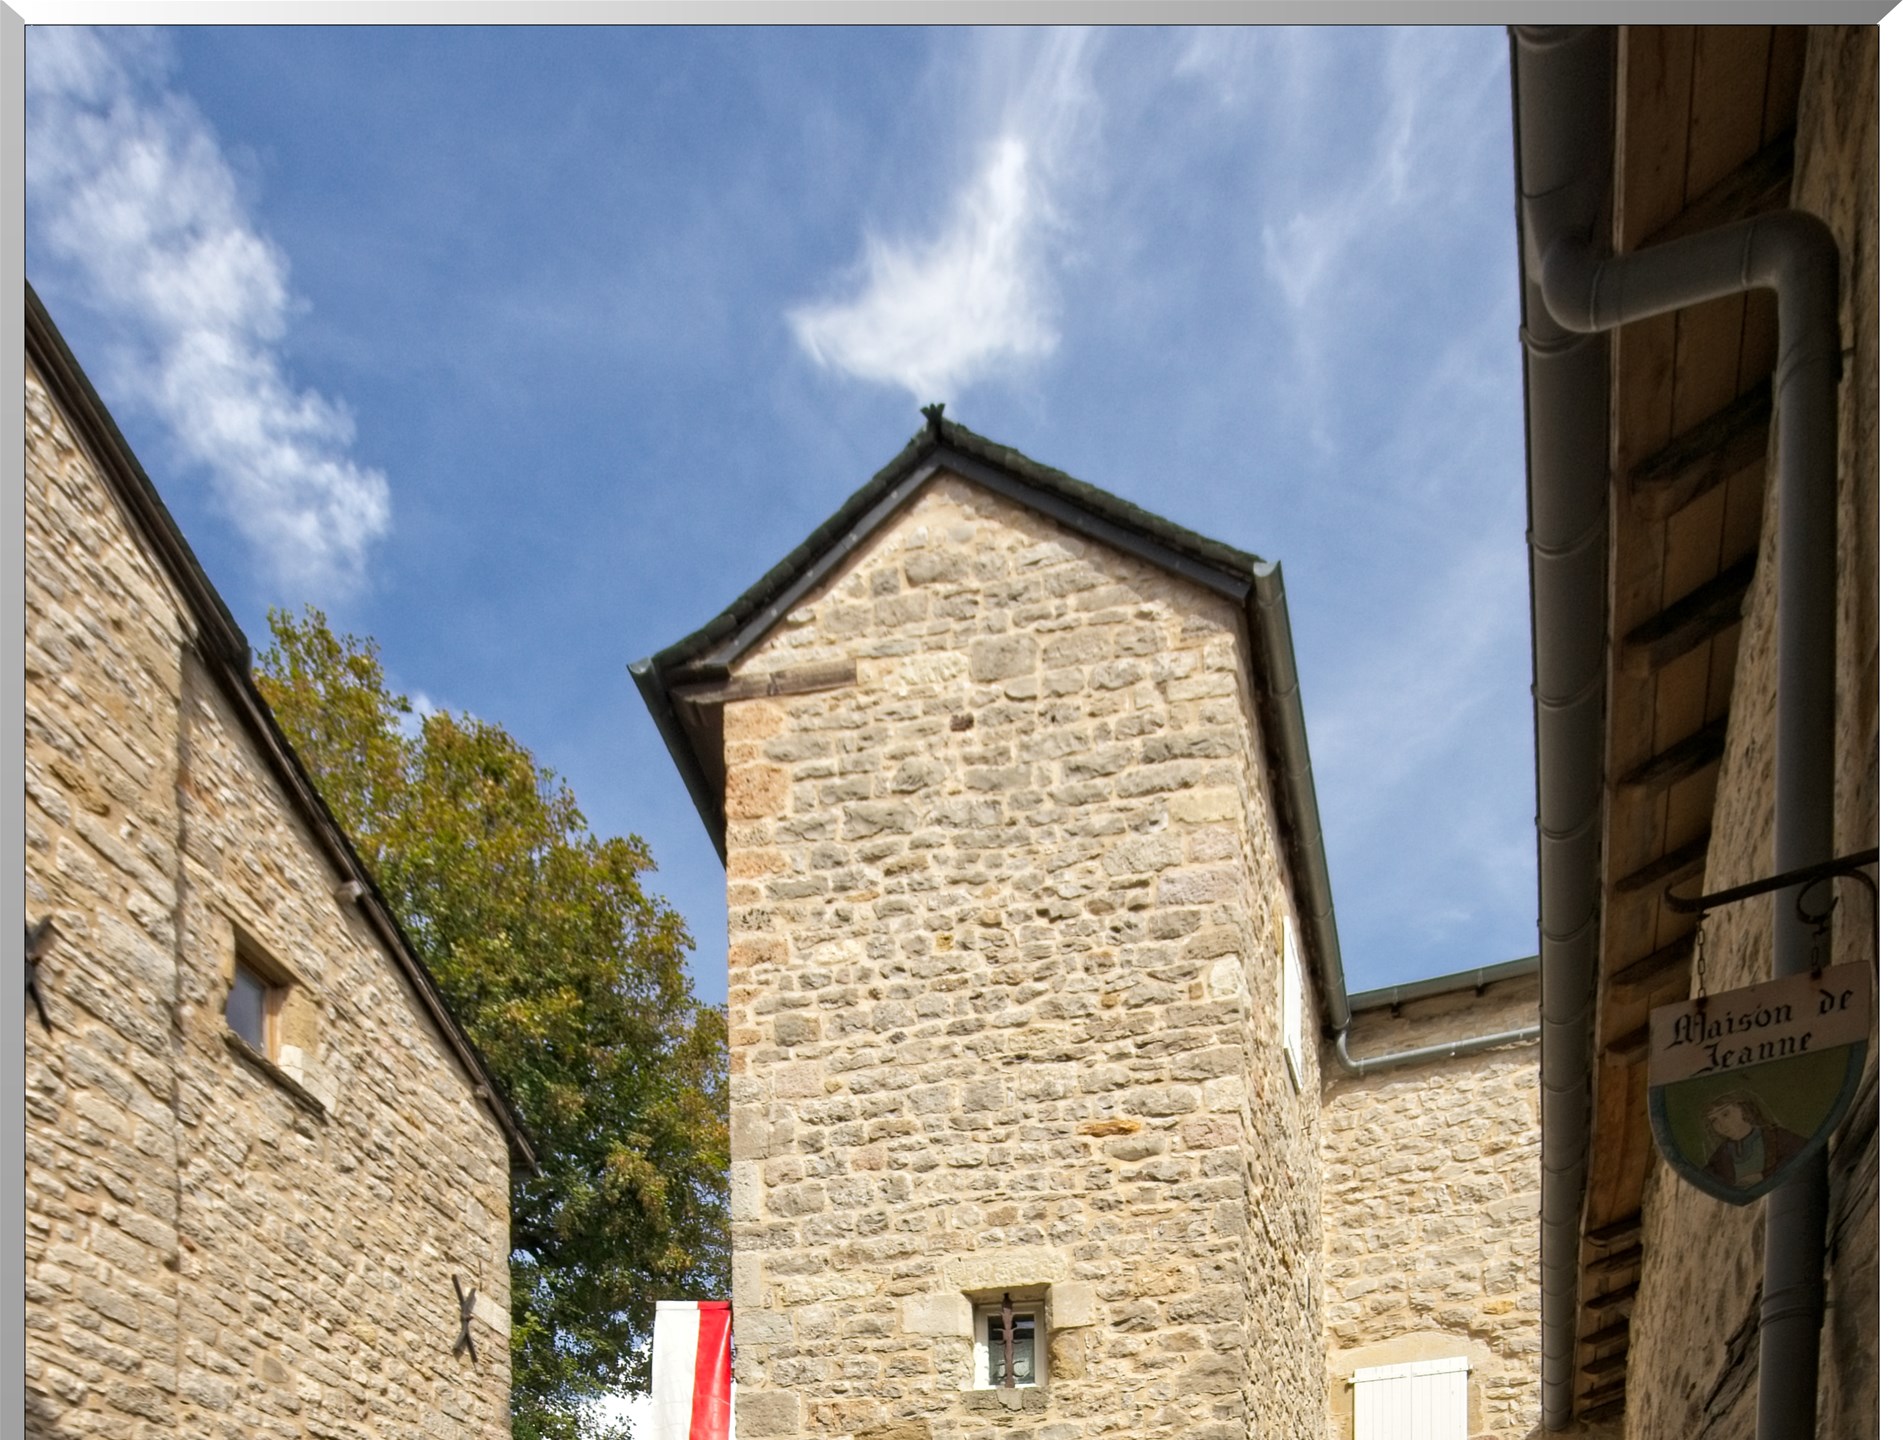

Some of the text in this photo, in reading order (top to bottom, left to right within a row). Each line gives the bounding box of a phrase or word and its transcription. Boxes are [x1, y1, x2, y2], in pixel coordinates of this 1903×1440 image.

[1664, 988, 1854, 1050] Maison de
[1690, 1031, 1812, 1077] Jeanne
